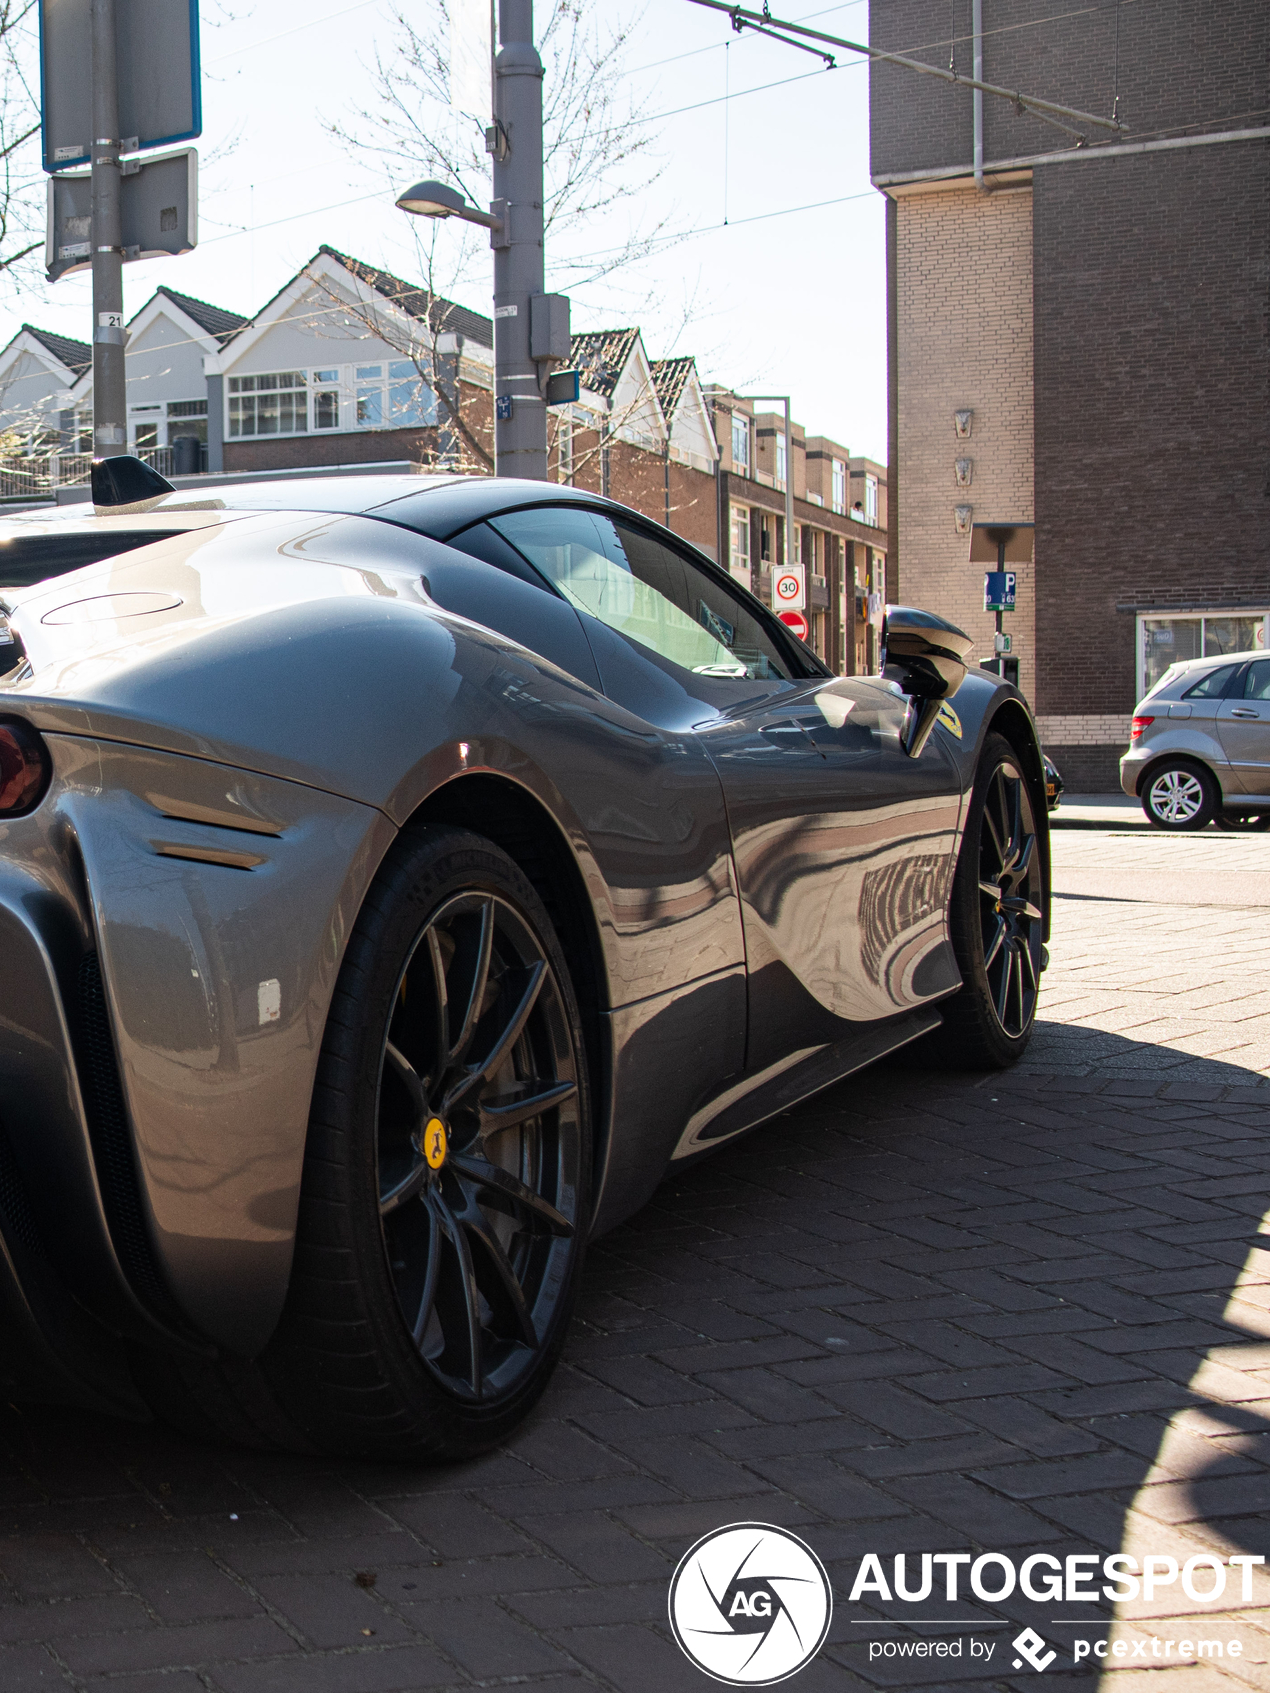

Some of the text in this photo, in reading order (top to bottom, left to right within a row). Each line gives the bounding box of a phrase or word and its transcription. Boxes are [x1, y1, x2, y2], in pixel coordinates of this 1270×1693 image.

[108, 315, 121, 326] 21
[781, 582, 796, 593] 30
[1005, 574, 1015, 592] P
